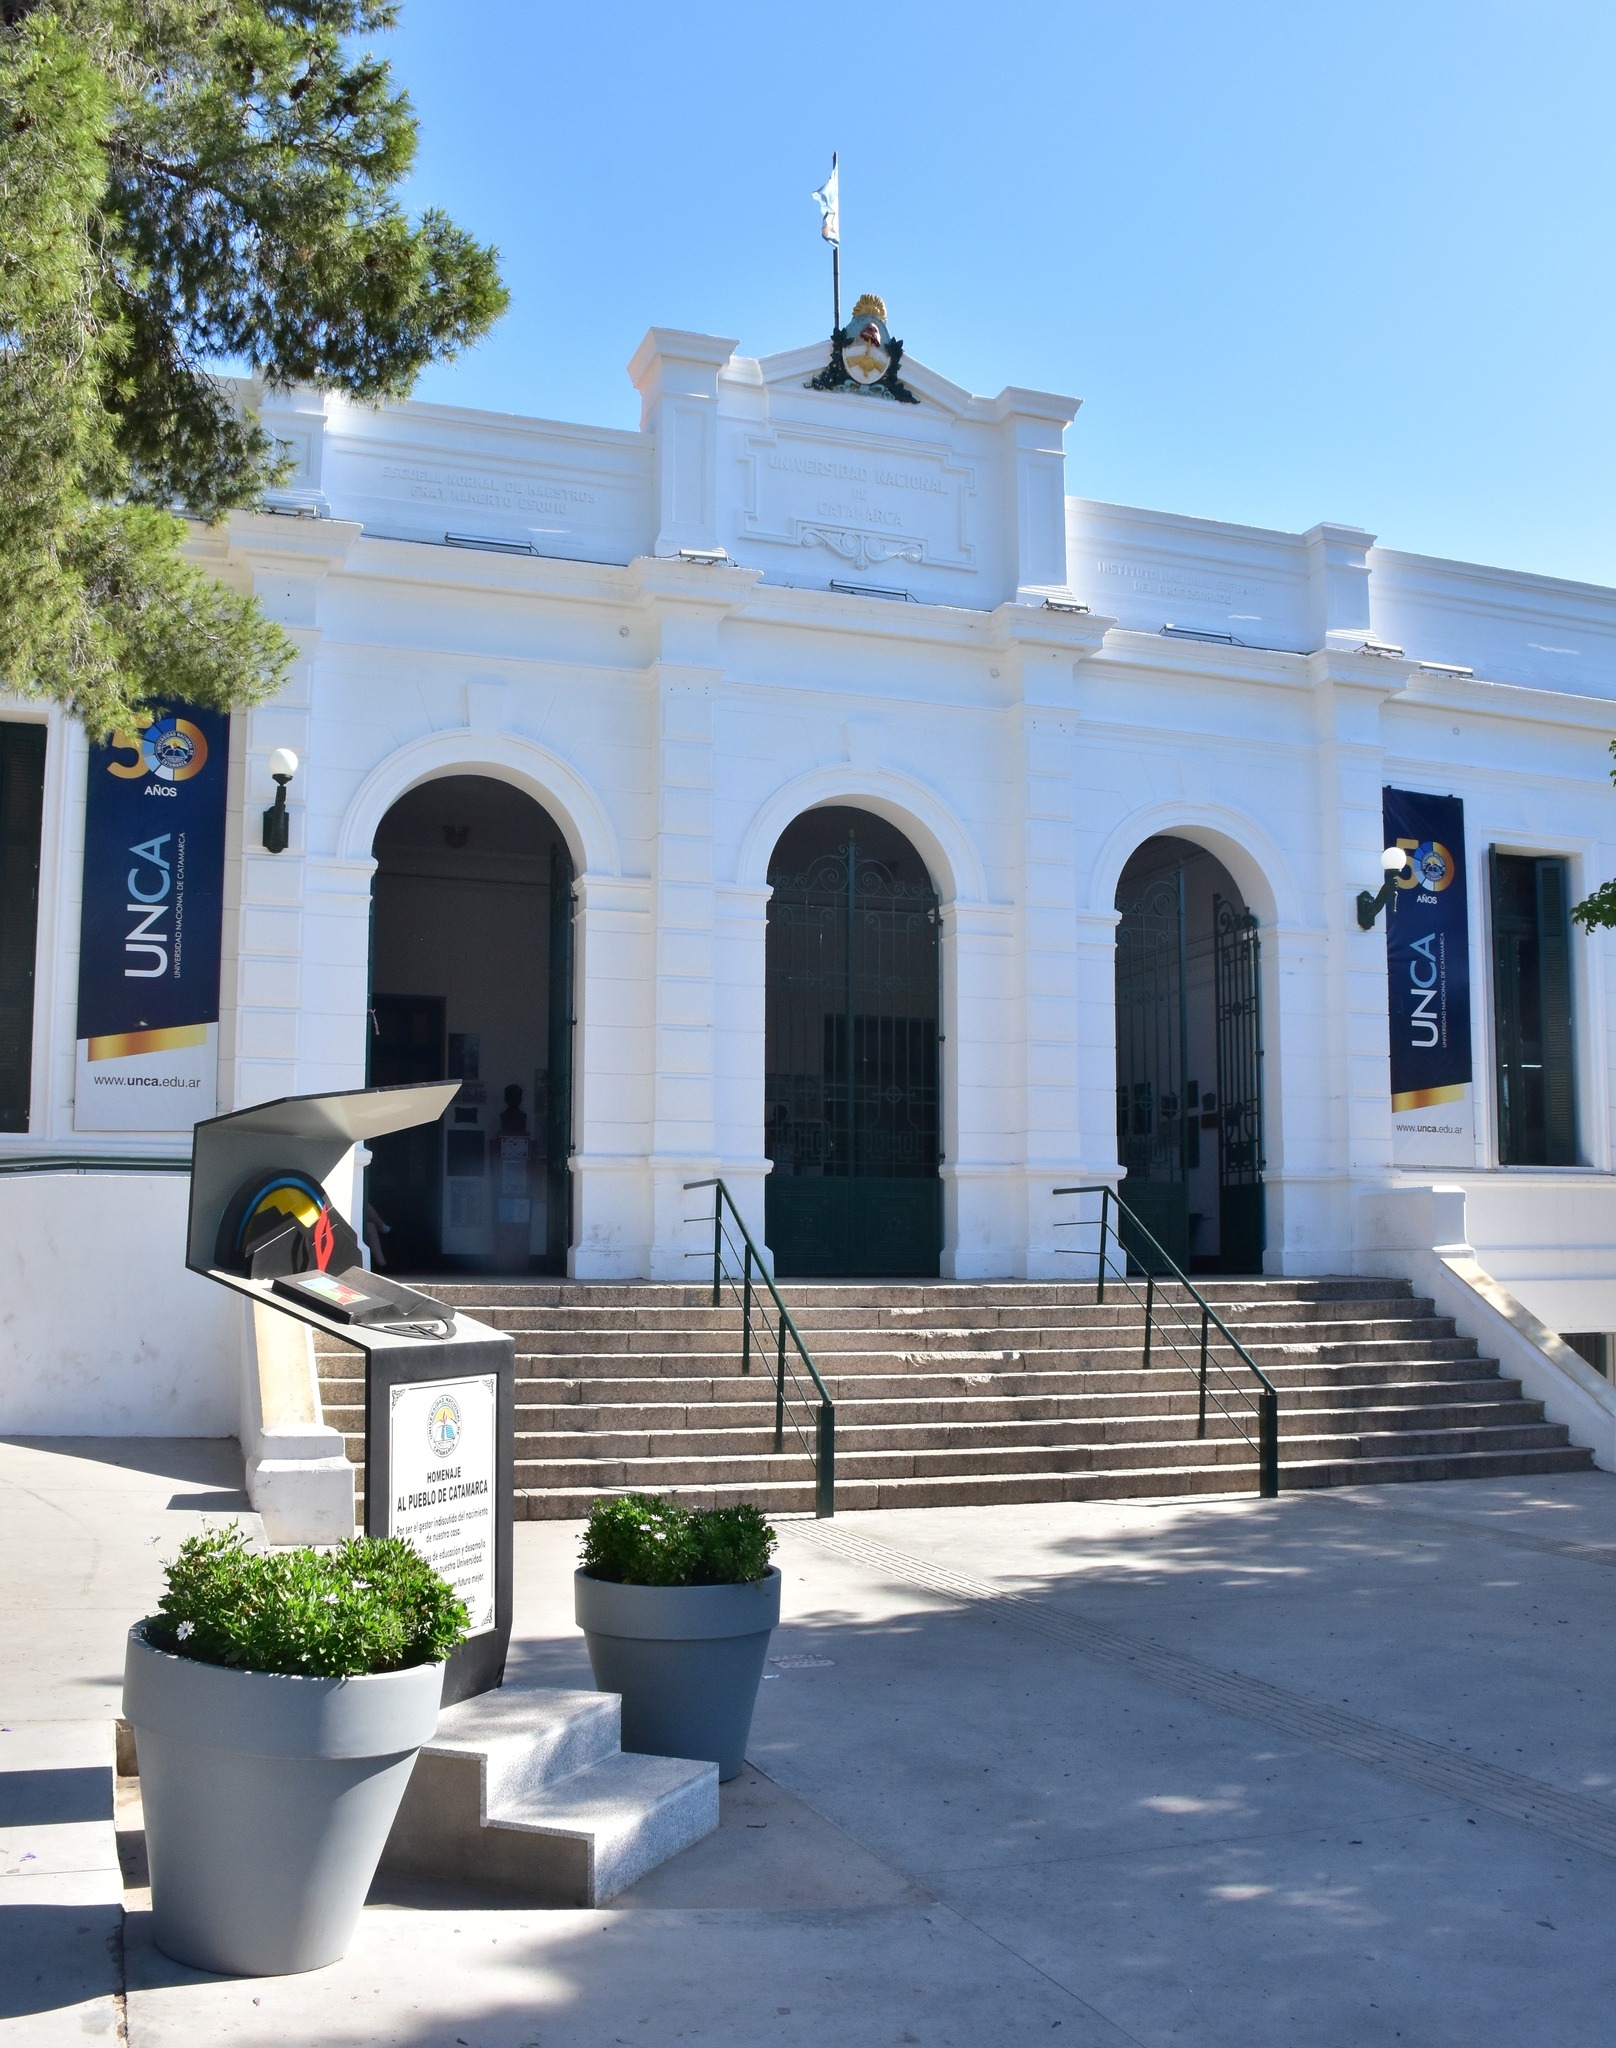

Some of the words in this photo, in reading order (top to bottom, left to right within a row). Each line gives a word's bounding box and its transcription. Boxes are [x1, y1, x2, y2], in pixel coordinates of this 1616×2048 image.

[381, 466, 442, 484] ESCUELA
[447, 473, 500, 492] NORMAL
[505, 481, 522, 494] DE
[527, 486, 596, 504] MAESTROS
[768, 454, 867, 481] UNIVERSIDAD
[875, 470, 949, 495] NACIONAL
[411, 485, 445, 500] FRAY
[450, 490, 511, 507] MAMERTO
[852, 487, 867, 501] DE
[818, 501, 904, 527] CATAMARCA
[1097, 561, 1157, 580] INSTITUTO
[1160, 571, 1213, 588] NACIONAL
[1133, 580, 1154, 593] DEL
[1158, 585, 1233, 605] PROFESORADO
[144, 785, 177, 797] AÑOS
[177, 832, 186, 880] CATAMARCA
[1396, 837, 1455, 892] 50
[177, 880, 184, 891] DE
[125, 833, 171, 978] UNCA
[175, 893, 183, 931] NACIONAL
[1416, 894, 1437, 904] AÑOS
[174, 931, 182, 979] UNIVERSIDAD
[1409, 932, 1438, 1047] UNCA
[94, 1076, 201, 1088] www.unca.edu.ar
[1396, 1124, 1463, 1134] www.unca.edu.ar
[427, 1467, 461, 1483] HOMENAJE
[397, 1496, 406, 1512] AL
[409, 1490, 436, 1510] PUEBLO
[438, 1487, 447, 1503] DE
[449, 1479, 488, 1501] CATAMARCA
[405, 1525, 413, 1534] ser
[414, 1521, 418, 1532] el
[419, 1520, 433, 1534] gestor
[434, 1512, 457, 1527] indiscutido
[466, 1507, 488, 1520] nacimiento
[426, 1532, 432, 1543] de
[432, 1551, 438, 1561] de
